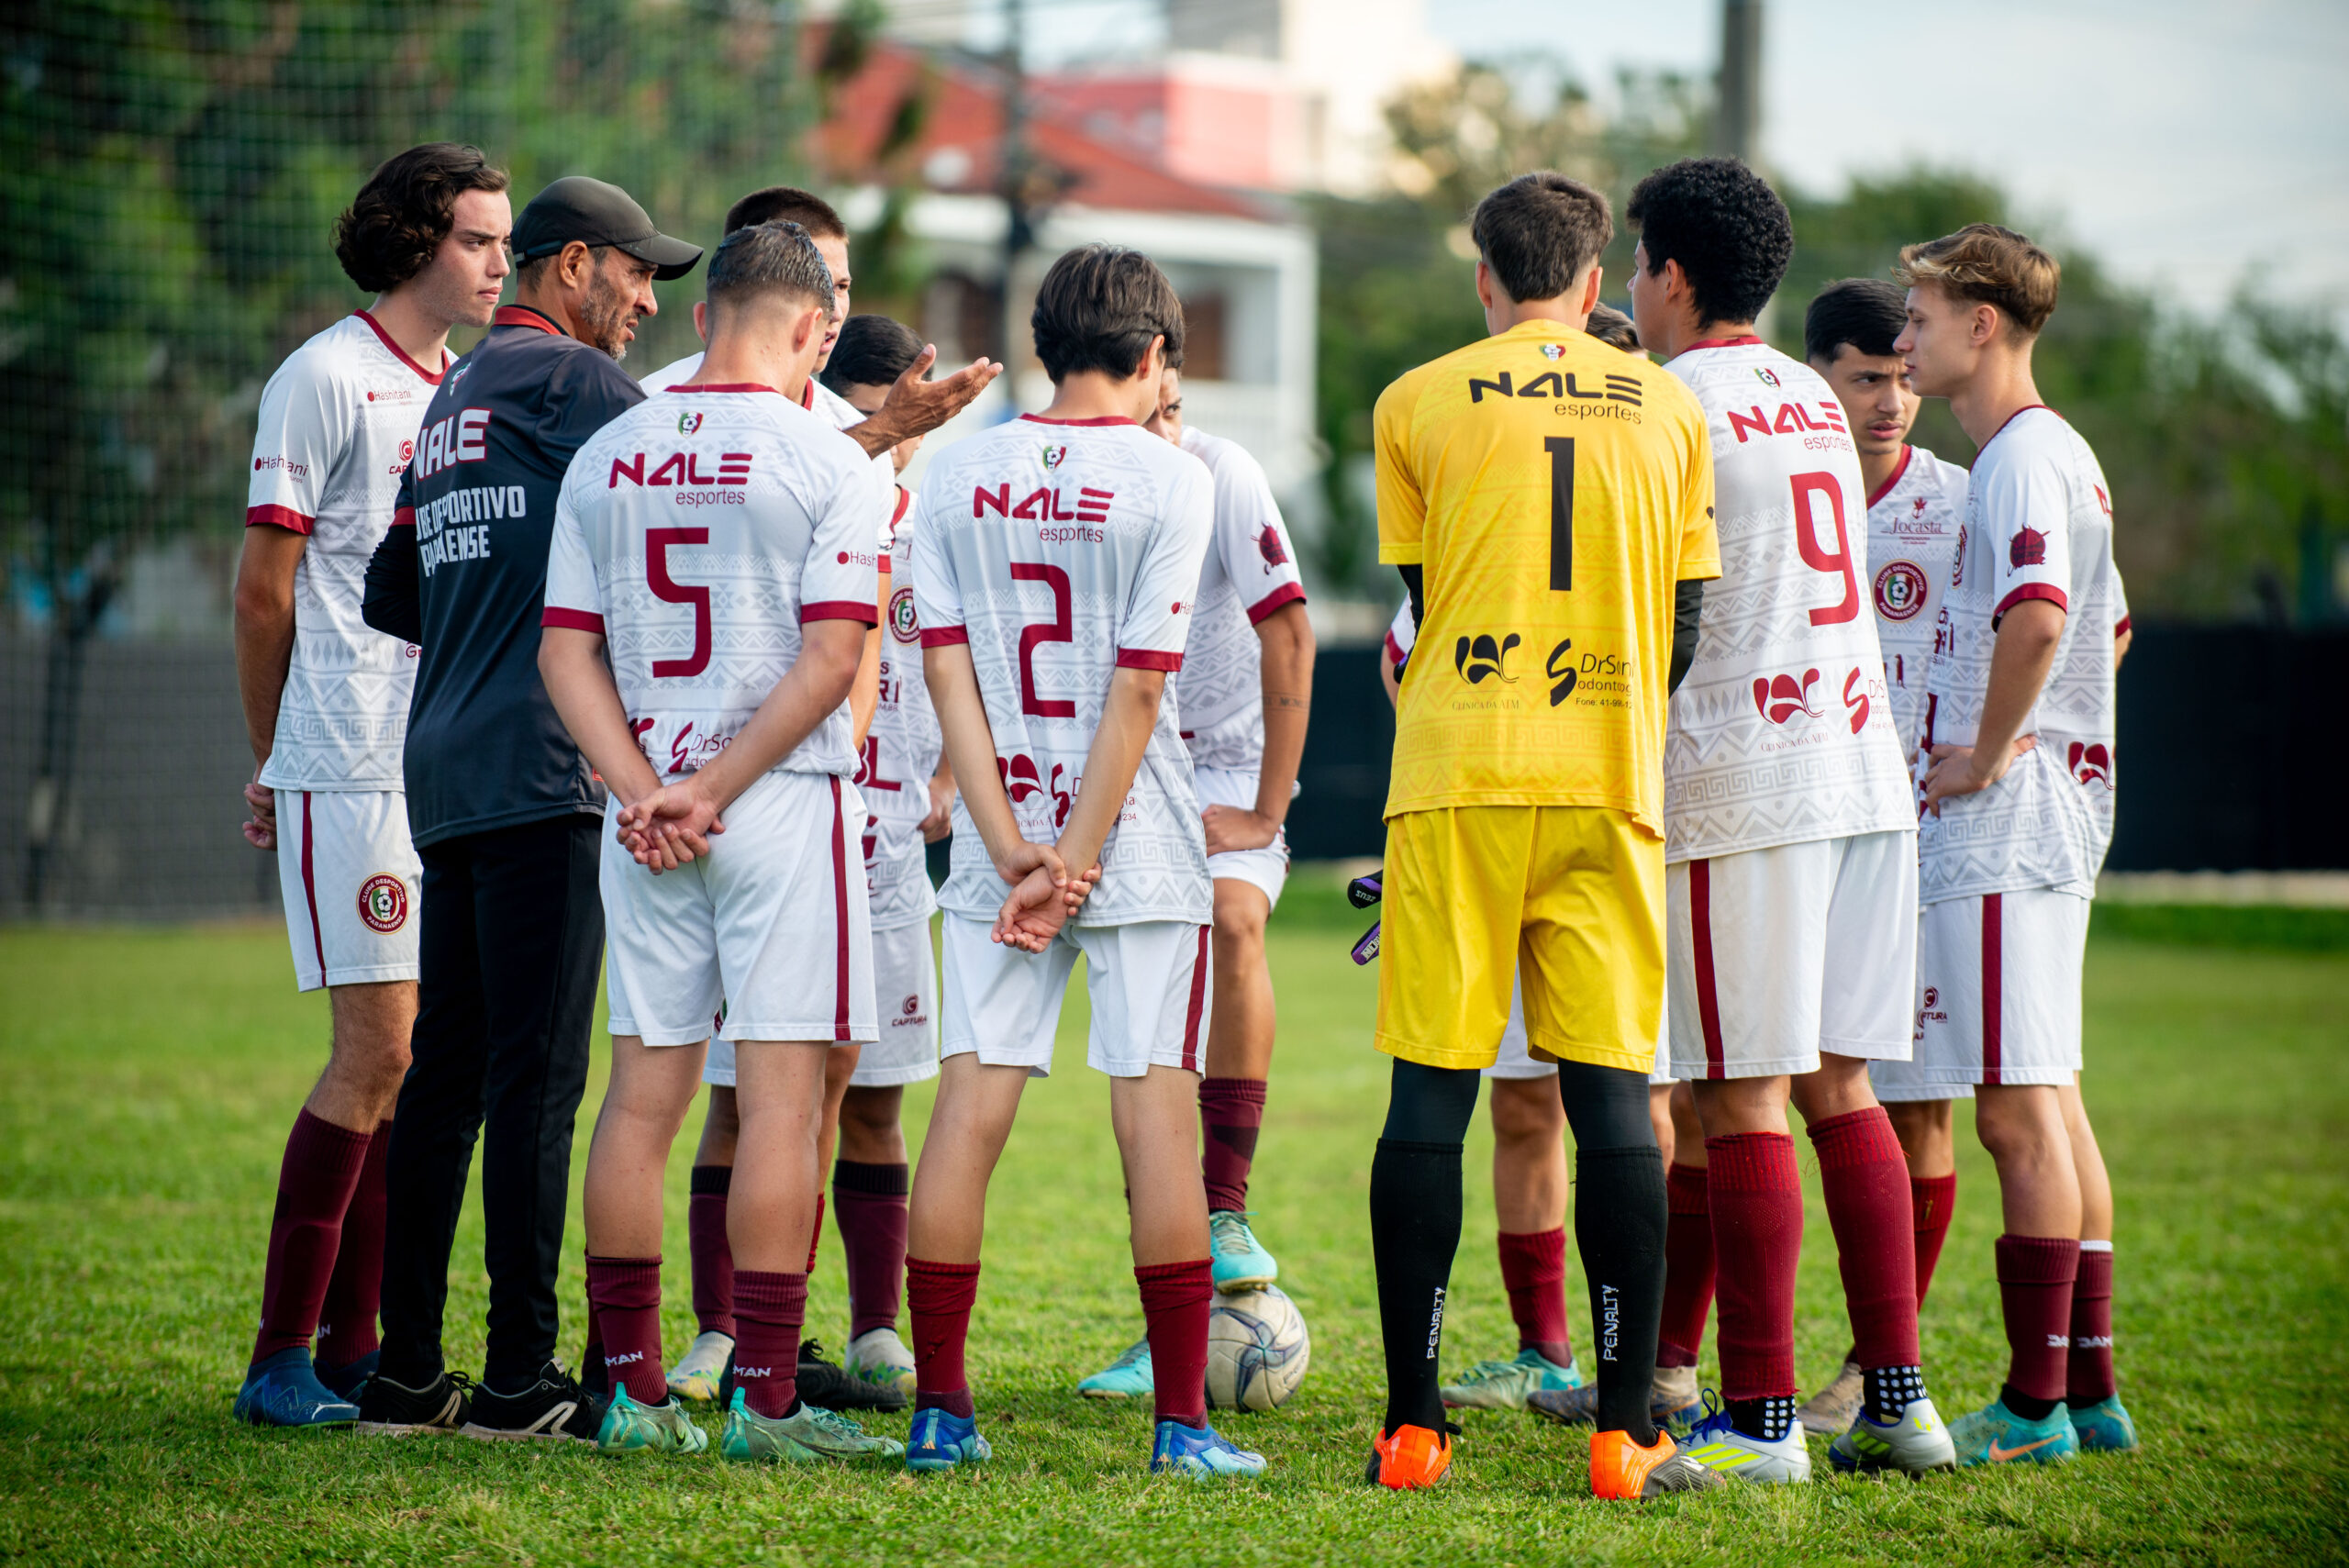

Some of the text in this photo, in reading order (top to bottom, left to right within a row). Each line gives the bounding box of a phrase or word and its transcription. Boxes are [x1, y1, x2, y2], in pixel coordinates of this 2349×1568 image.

[373, 389, 412, 400] Hashitani
[1469, 372, 1642, 407] NALE
[1554, 403, 1642, 425] esportes
[1727, 401, 1846, 442] NALE
[414, 406, 493, 482] NALE
[608, 452, 753, 489] NALE
[675, 488, 746, 508] esportes
[973, 483, 1115, 523] NALE
[1544, 436, 1575, 591] 1
[1040, 525, 1104, 545] esportes
[1890, 517, 1943, 534] Jocasta
[1790, 472, 1860, 628] 9
[646, 527, 712, 678] 5
[1010, 562, 1075, 718] 2
[362, 878, 406, 903] CLUBE DESPORTIVO
[367, 914, 404, 929] PARANAENSE
[1427, 1286, 1446, 1360] PENALTY
[1602, 1284, 1620, 1362] PENALTY
